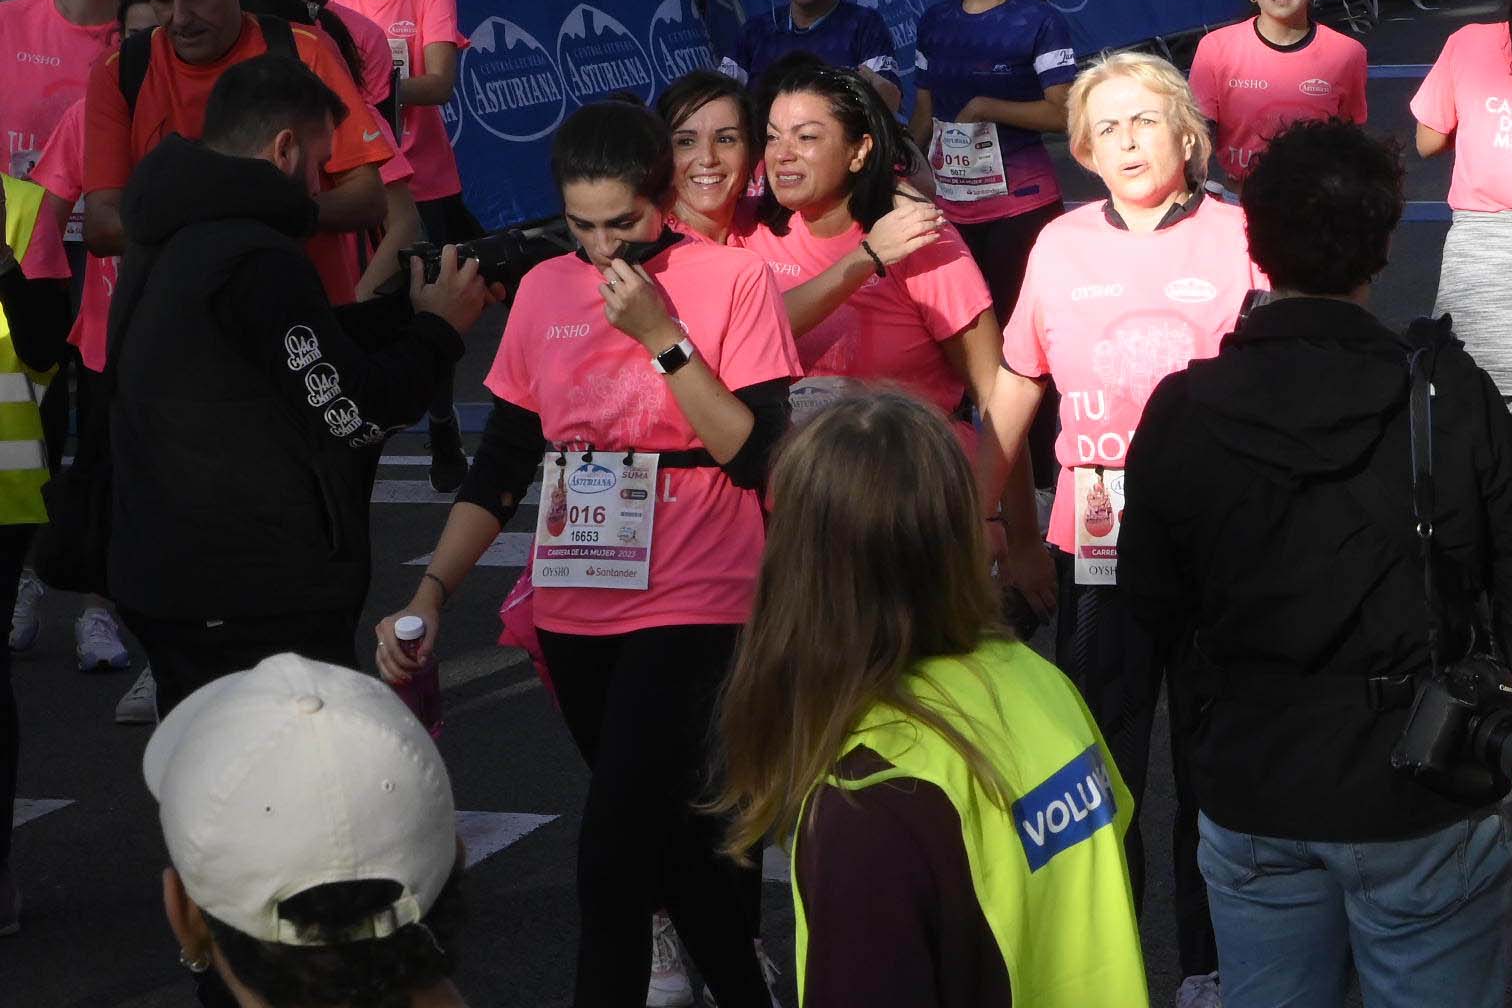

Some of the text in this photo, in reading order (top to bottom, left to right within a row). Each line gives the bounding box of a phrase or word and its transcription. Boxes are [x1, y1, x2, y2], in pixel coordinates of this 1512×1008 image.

[17, 51, 61, 66] OYSHO
[566, 52, 650, 97] ASTURIANA
[1228, 79, 1268, 90] OYSHO
[470, 67, 562, 116] ASTURIANA
[945, 154, 970, 167] 016
[1228, 145, 1253, 168] TU
[546, 323, 590, 340] OYSHO
[1068, 389, 1105, 421] TU
[571, 476, 613, 488] ASTURIANA
[621, 471, 648, 481] SUMA
[569, 505, 606, 525] 016
[571, 530, 599, 543] 16653
[547, 549, 572, 558] CARRERA
[580, 549, 590, 558] LA
[590, 549, 616, 558] MUJER
[1091, 548, 1117, 557] CARRE
[542, 566, 638, 578] OYSHO Santander
[1088, 566, 1117, 576] OYSH
